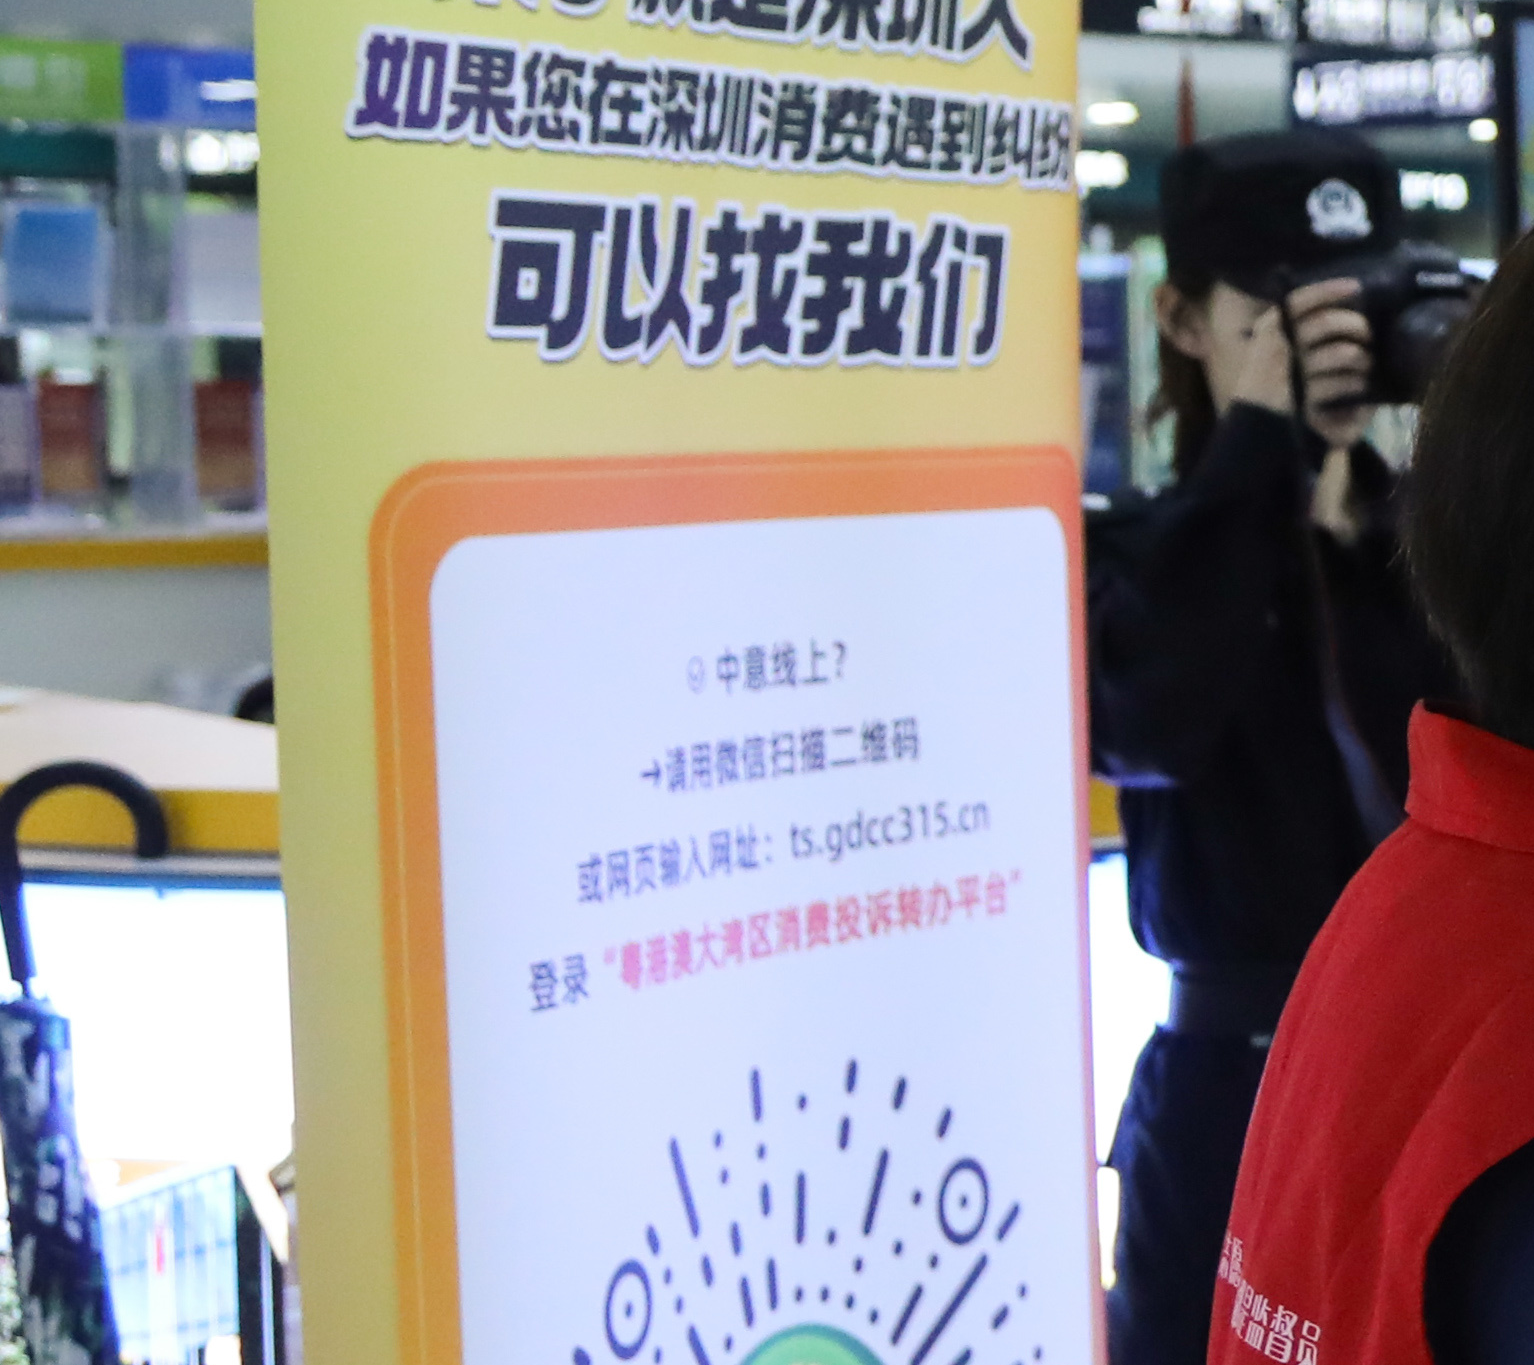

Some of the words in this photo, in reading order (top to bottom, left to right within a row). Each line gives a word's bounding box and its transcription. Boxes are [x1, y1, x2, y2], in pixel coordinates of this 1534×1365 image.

[350, 30, 1074, 189] 如果您在深圳消费遇到纠纷
[490, 198, 1006, 363] 可以找我们
[664, 717, 921, 793] 请用微信扫描二维码
[788, 799, 991, 865] ts.gdcc315.cn
